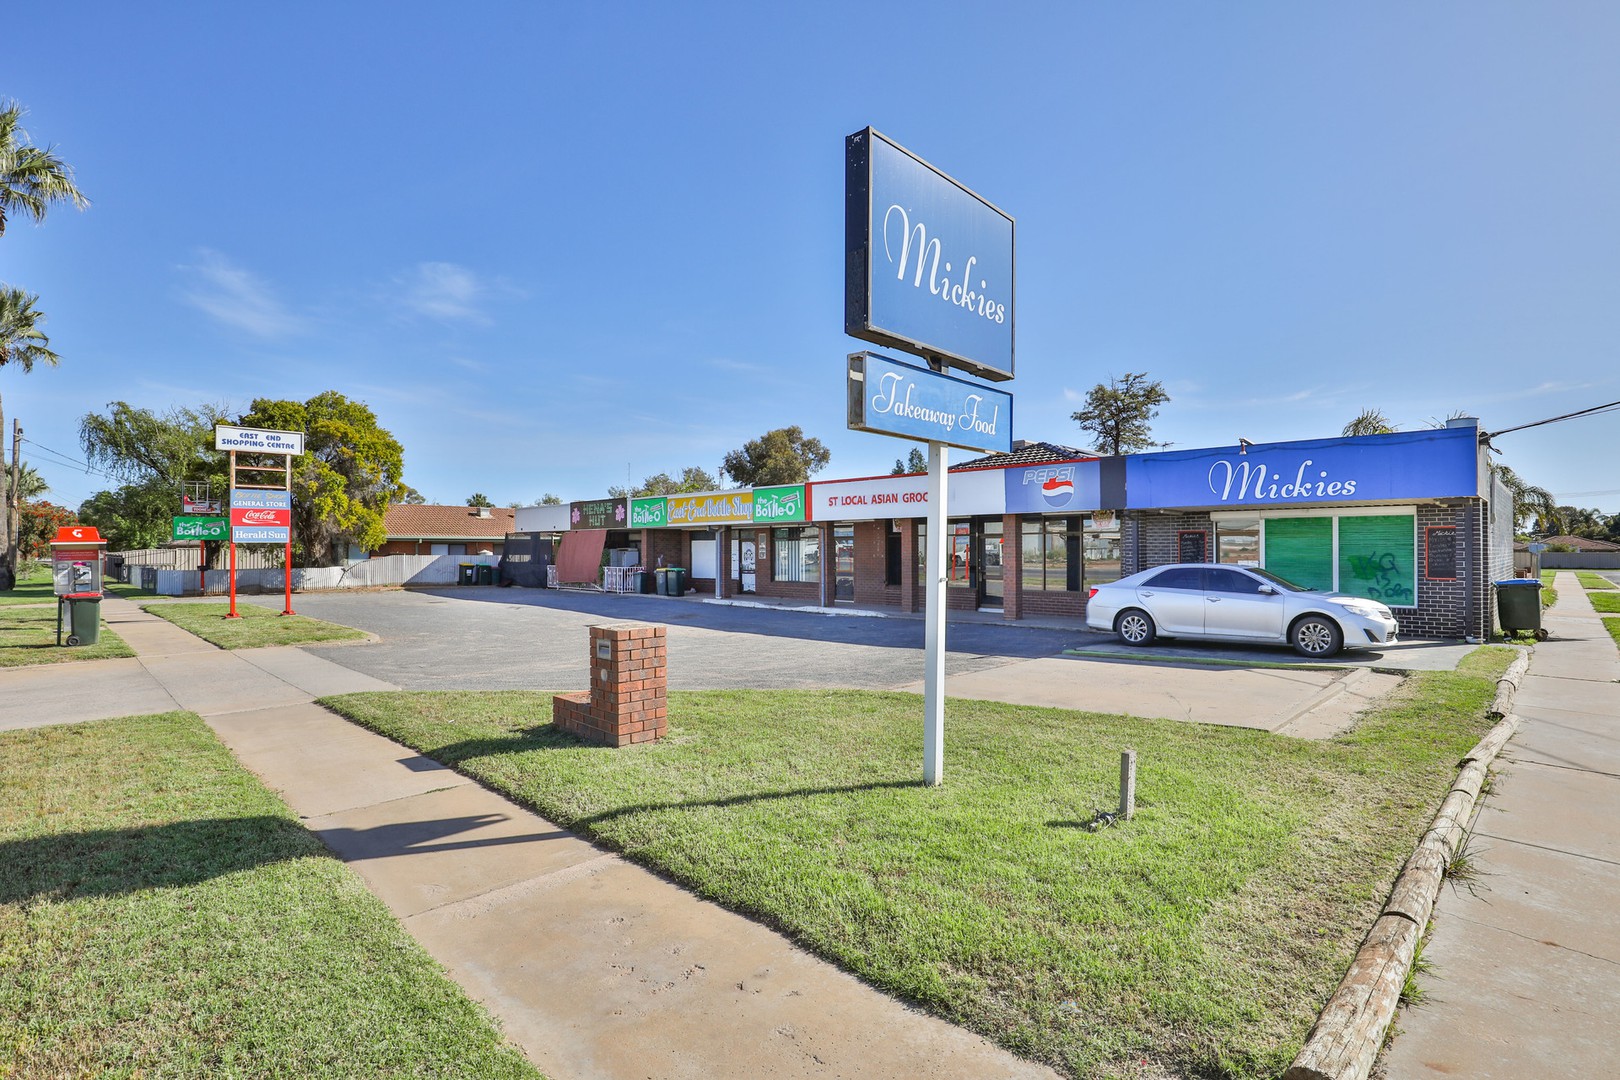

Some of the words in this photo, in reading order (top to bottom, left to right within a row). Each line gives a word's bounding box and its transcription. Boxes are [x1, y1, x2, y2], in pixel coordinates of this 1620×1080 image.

[883, 204, 1005, 324] Mickies
[872, 371, 957, 432] Takeaway
[958, 394, 998, 436] Food
[239, 432, 259, 440] EAST
[265, 434, 281, 442] END
[221, 438, 265, 448] SHOPPING
[267, 441, 295, 450] CENTRE
[1022, 466, 1076, 485] PEPSI
[1208, 459, 1356, 501] Mickies
[757, 497, 768, 505] the
[841, 495, 868, 506] LOCAL
[871, 493, 898, 505] ASIAN
[902, 491, 928, 503] GROC
[245, 510, 277, 519] Coca-Cola
[667, 499, 688, 522] East
[687, 496, 708, 522] End
[707, 495, 732, 518] Bottle
[732, 496, 753, 518] Shop
[589, 515, 606, 527] HUT
[235, 531, 267, 540] Herald
[267, 532, 287, 540] Sun
